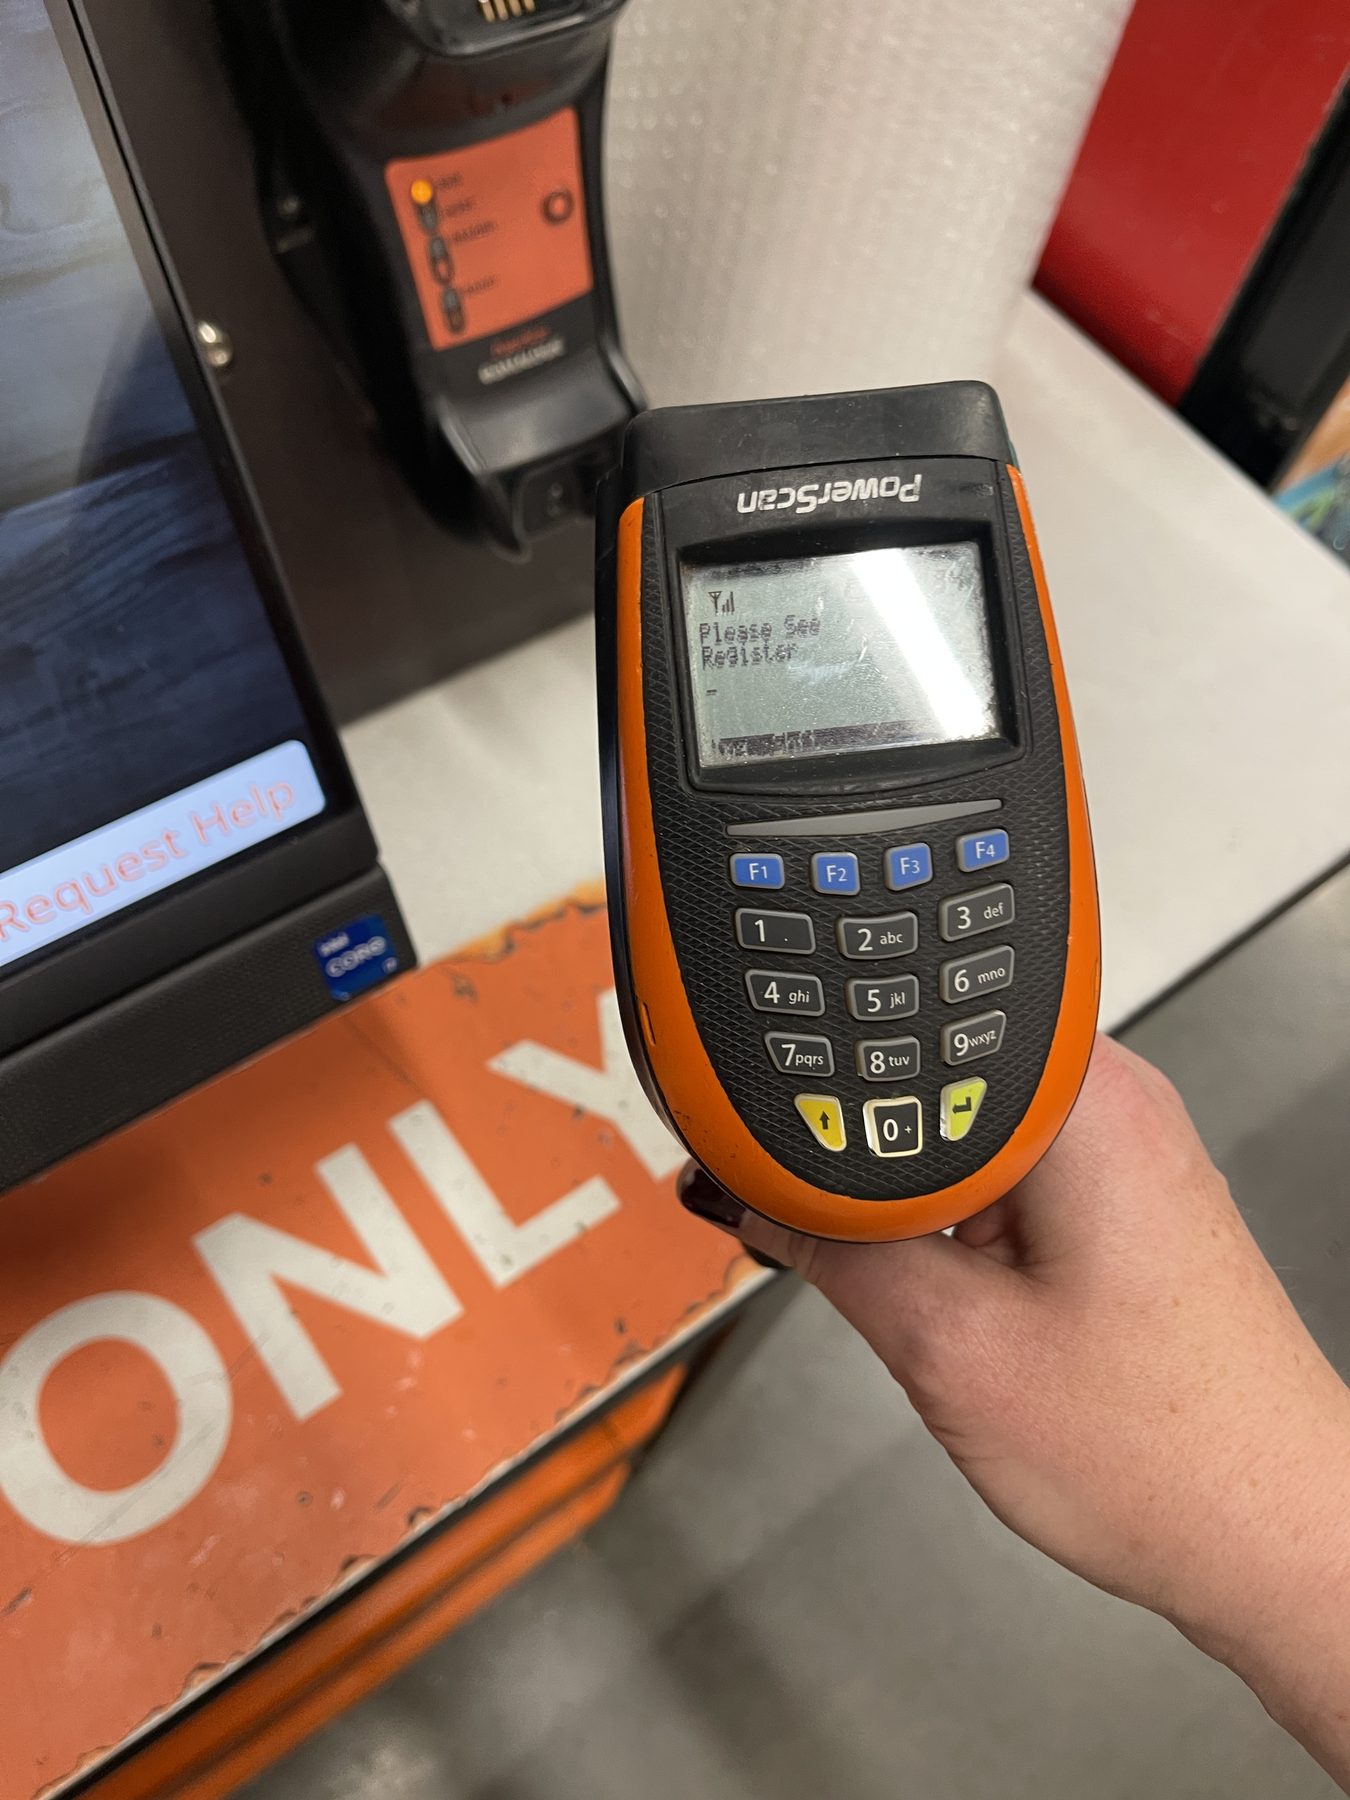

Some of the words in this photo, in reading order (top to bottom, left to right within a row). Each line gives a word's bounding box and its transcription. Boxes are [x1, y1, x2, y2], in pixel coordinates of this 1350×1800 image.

[737, 474, 922, 514] PowerScan
[699, 622, 772, 645] Please
[784, 615, 821, 639] See
[702, 644, 797, 670] Register
[0, 827, 188, 941] Request
[189, 780, 296, 844] Help
[975, 841, 996, 860] F4
[748, 862, 769, 881] F1
[826, 865, 848, 883] F2
[899, 856, 921, 876] F3
[956, 906, 971, 930] 3
[983, 902, 1004, 920] def
[754, 918, 766, 942] 1
[857, 928, 873, 952] 2
[879, 930, 904, 945] abc
[954, 968, 970, 993] 6
[977, 966, 1006, 985] mno
[763, 981, 781, 1004] 4
[788, 990, 811, 1005] ghi
[867, 989, 882, 1013] 5
[888, 992, 906, 1009] jkl
[869, 1051, 886, 1074] 8
[888, 1054, 910, 1067] tuv
[0, 988, 692, 1548] ONLY
